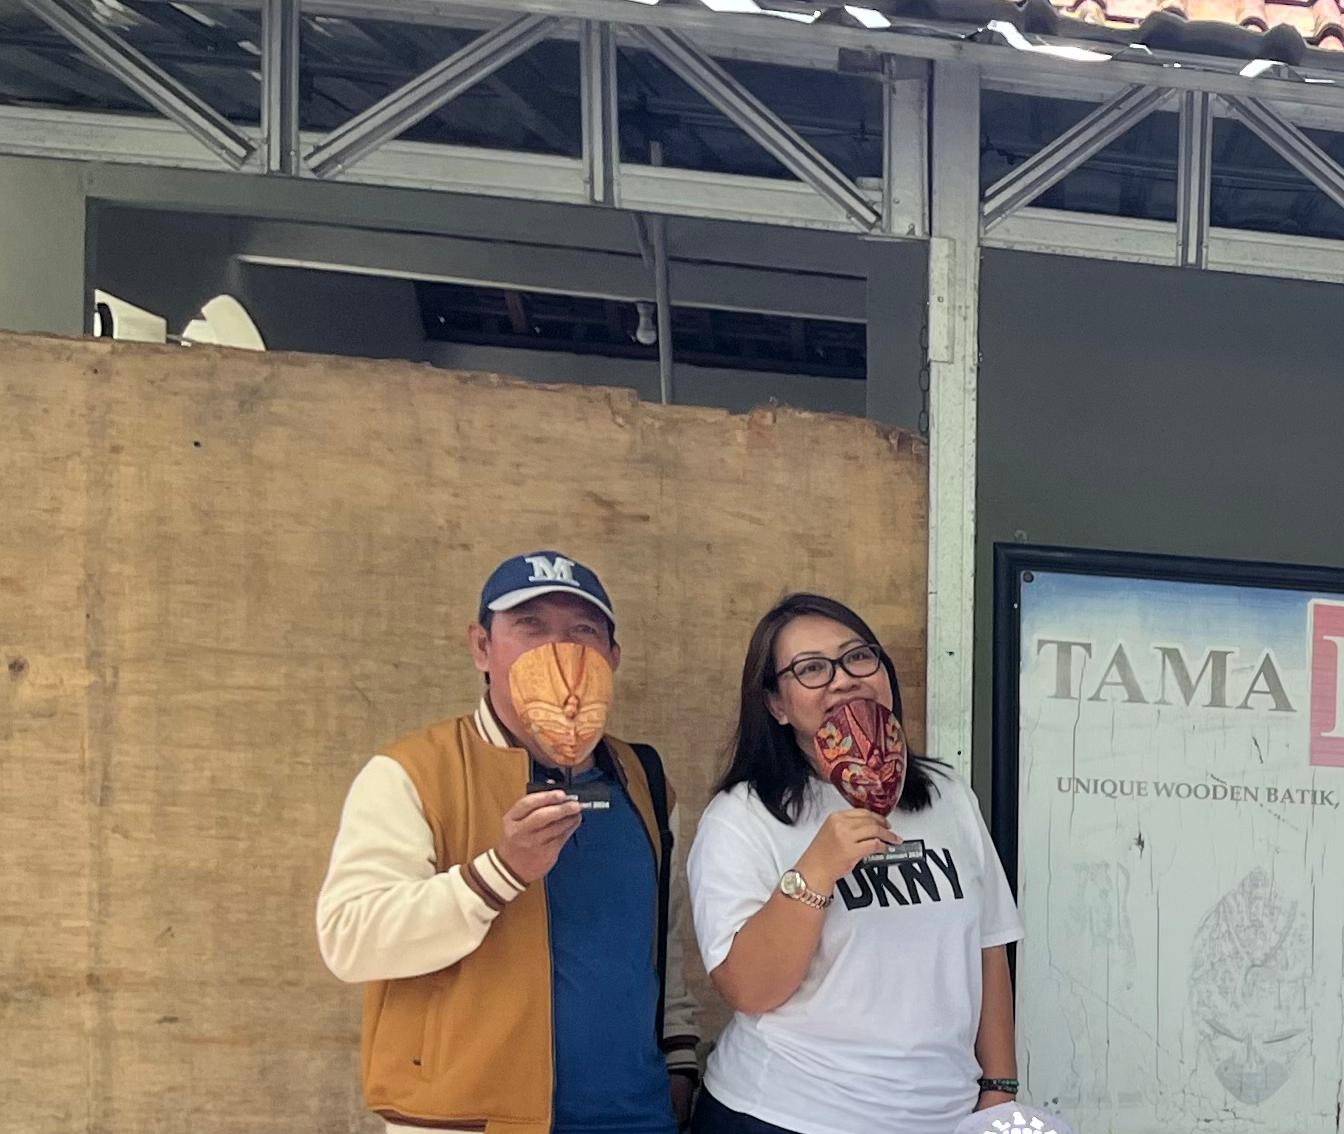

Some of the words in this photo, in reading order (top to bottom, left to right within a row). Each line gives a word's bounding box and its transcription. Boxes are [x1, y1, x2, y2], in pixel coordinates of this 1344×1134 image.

[524, 555, 580, 587] M
[1057, 776, 1148, 799] UNIQUE
[1153, 780, 1259, 803] WOODEN
[1266, 786, 1340, 809] BATIK,
[836, 847, 963, 910] DKNY
